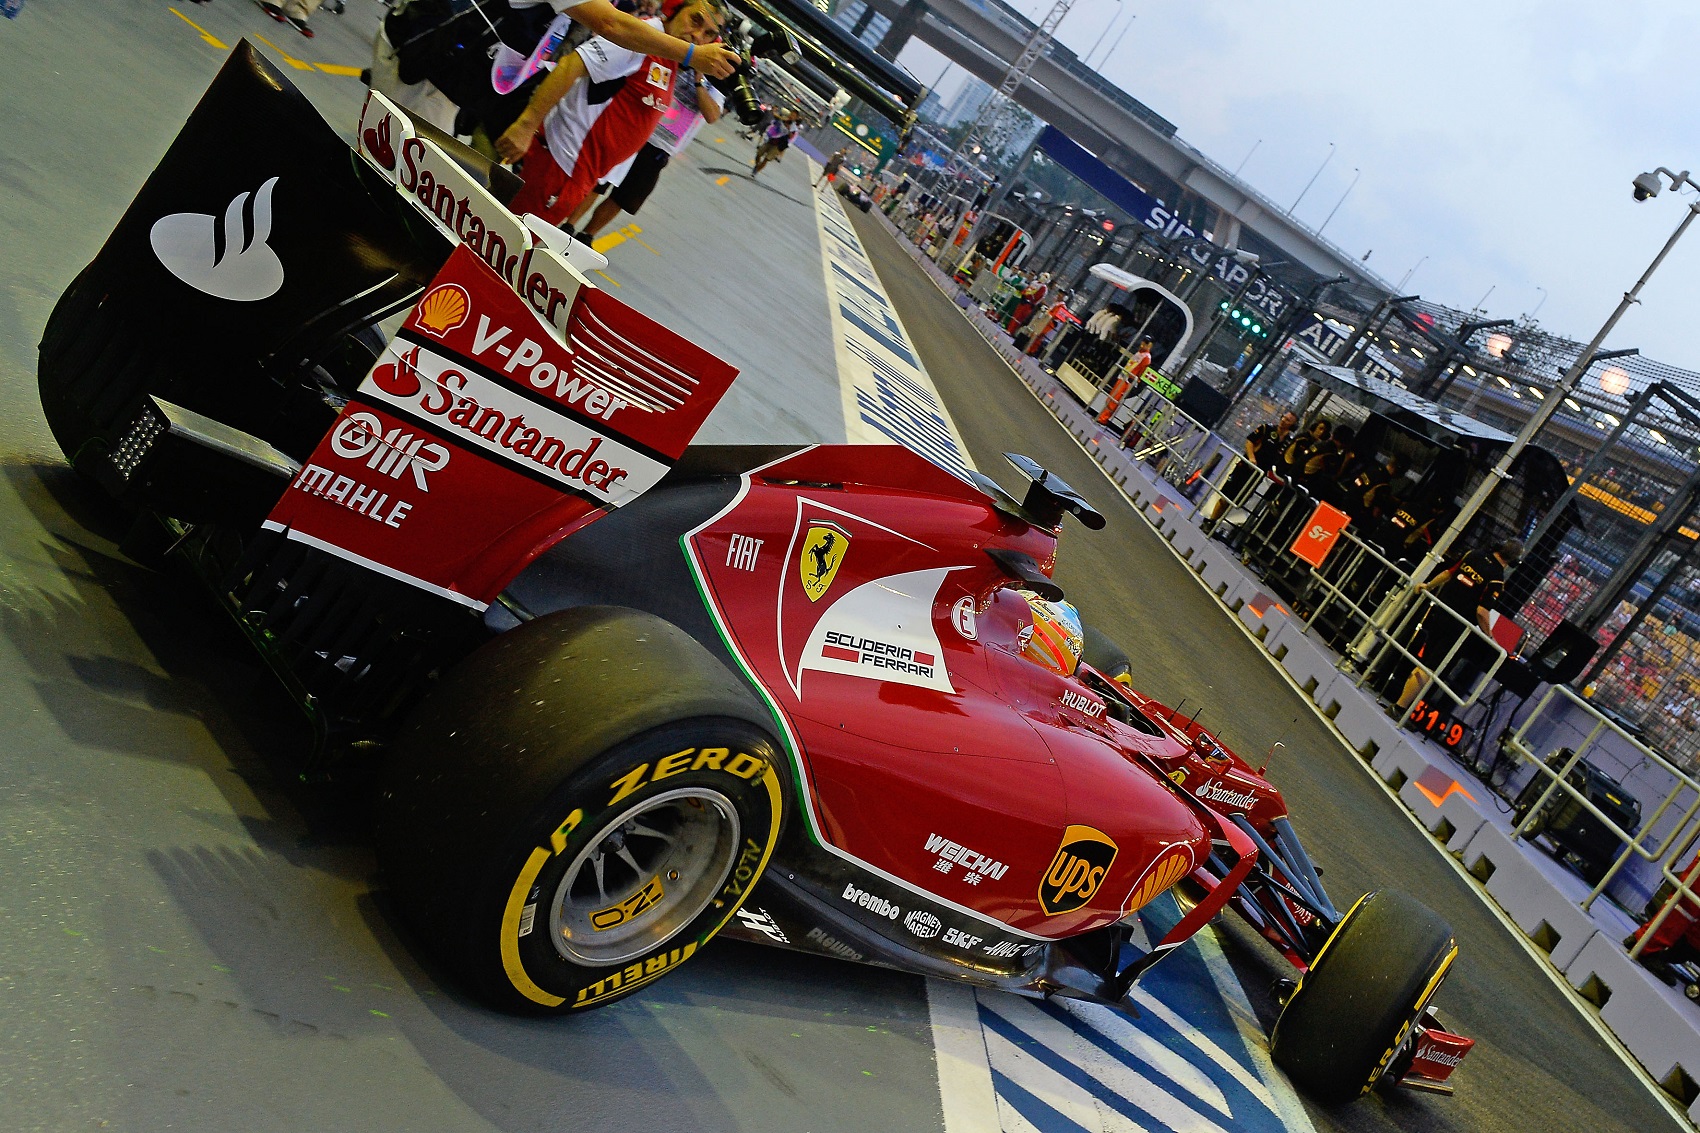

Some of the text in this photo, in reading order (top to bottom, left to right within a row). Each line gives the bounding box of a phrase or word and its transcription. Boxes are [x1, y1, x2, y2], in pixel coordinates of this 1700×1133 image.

[400, 137, 568, 329] Santander
[469, 314, 628, 421] V-Power
[418, 368, 629, 494] Santander
[293, 463, 413, 529] MAHLE
[725, 533, 764, 572] FIAT
[824, 630, 913, 661] SCUDERIA
[860, 652, 934, 679] FERRARI
[1061, 689, 1107, 719] HUBLOT
[550, 747, 766, 856] P ZERO
[1207, 780, 1259, 811] Santander
[923, 832, 1010, 881] WEICHAI
[841, 883, 900, 921] brembo
[942, 927, 983, 950] SKF
[571, 940, 699, 1008] PIRELLI
[1423, 1044, 1463, 1068] Santander
